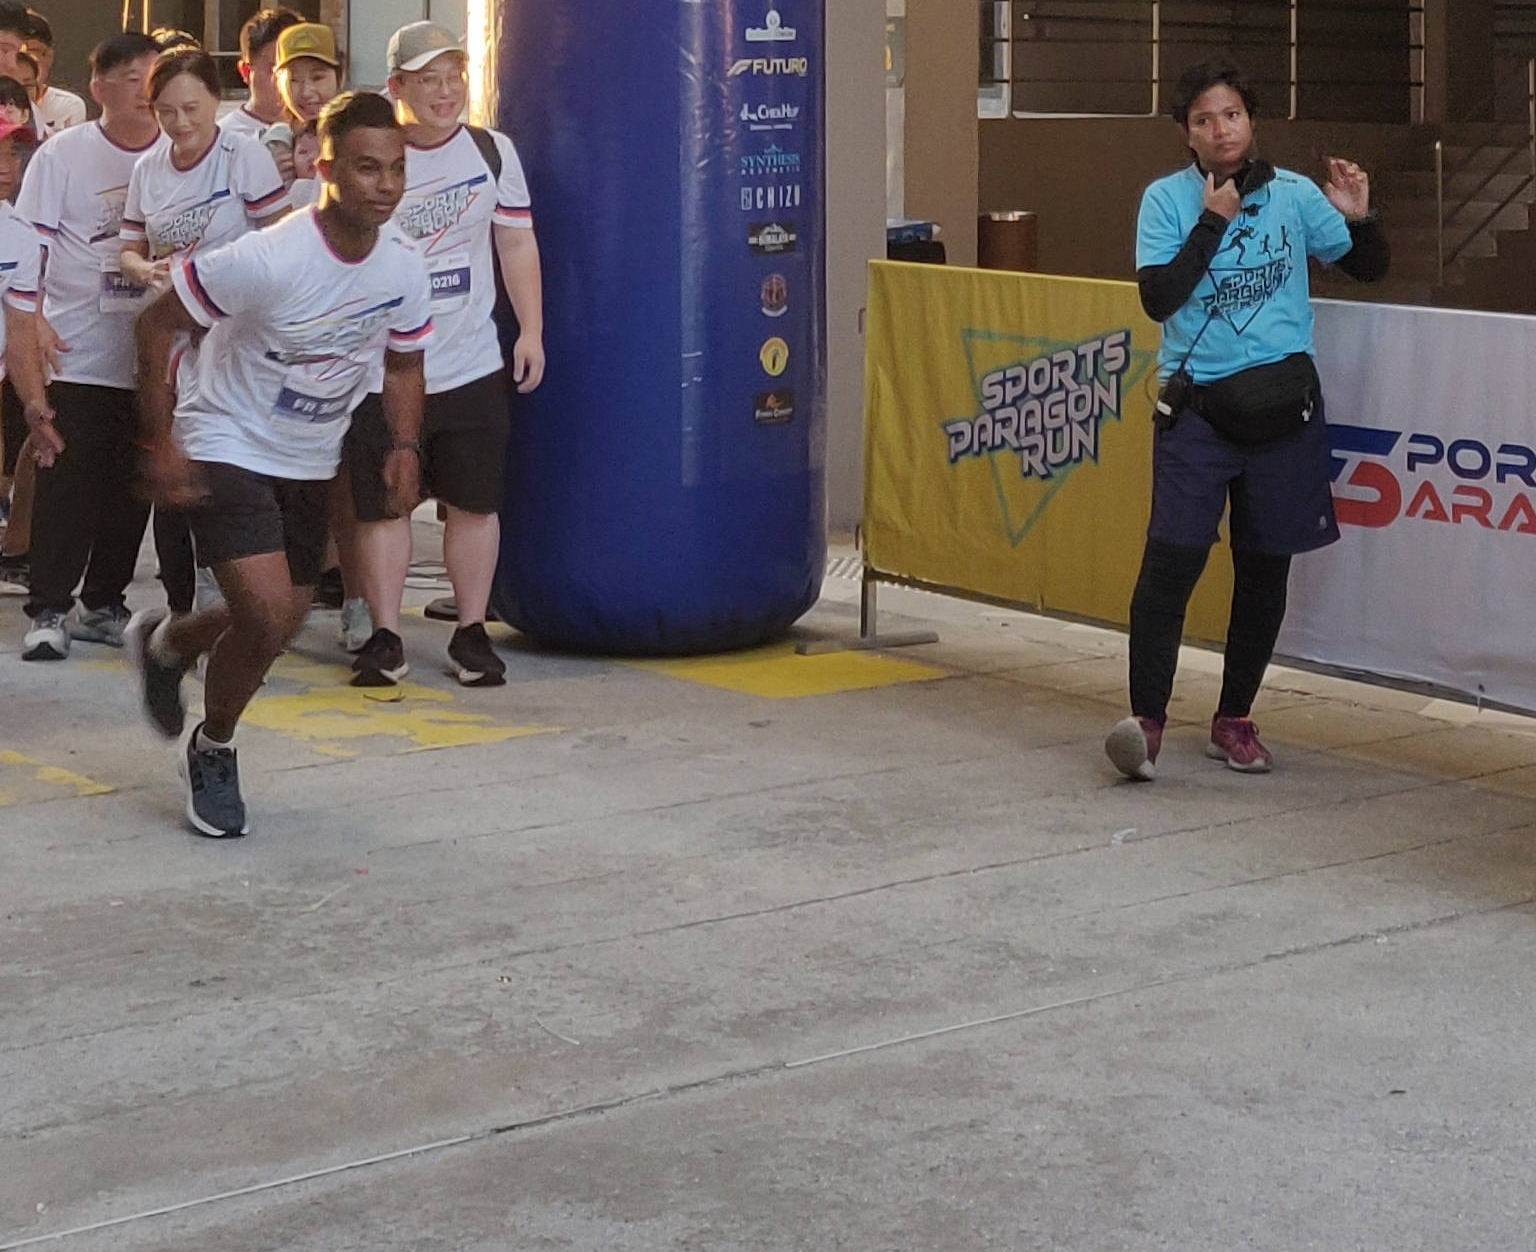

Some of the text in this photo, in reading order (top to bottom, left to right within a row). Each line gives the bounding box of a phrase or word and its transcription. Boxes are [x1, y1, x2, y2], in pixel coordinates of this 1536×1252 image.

[752, 57, 808, 76] FUTURO
[740, 153, 801, 168] SYNTHESIS
[980, 329, 1133, 412] SPORTS
[943, 373, 1123, 464] PARAGON
[1019, 416, 1100, 481] RUN
